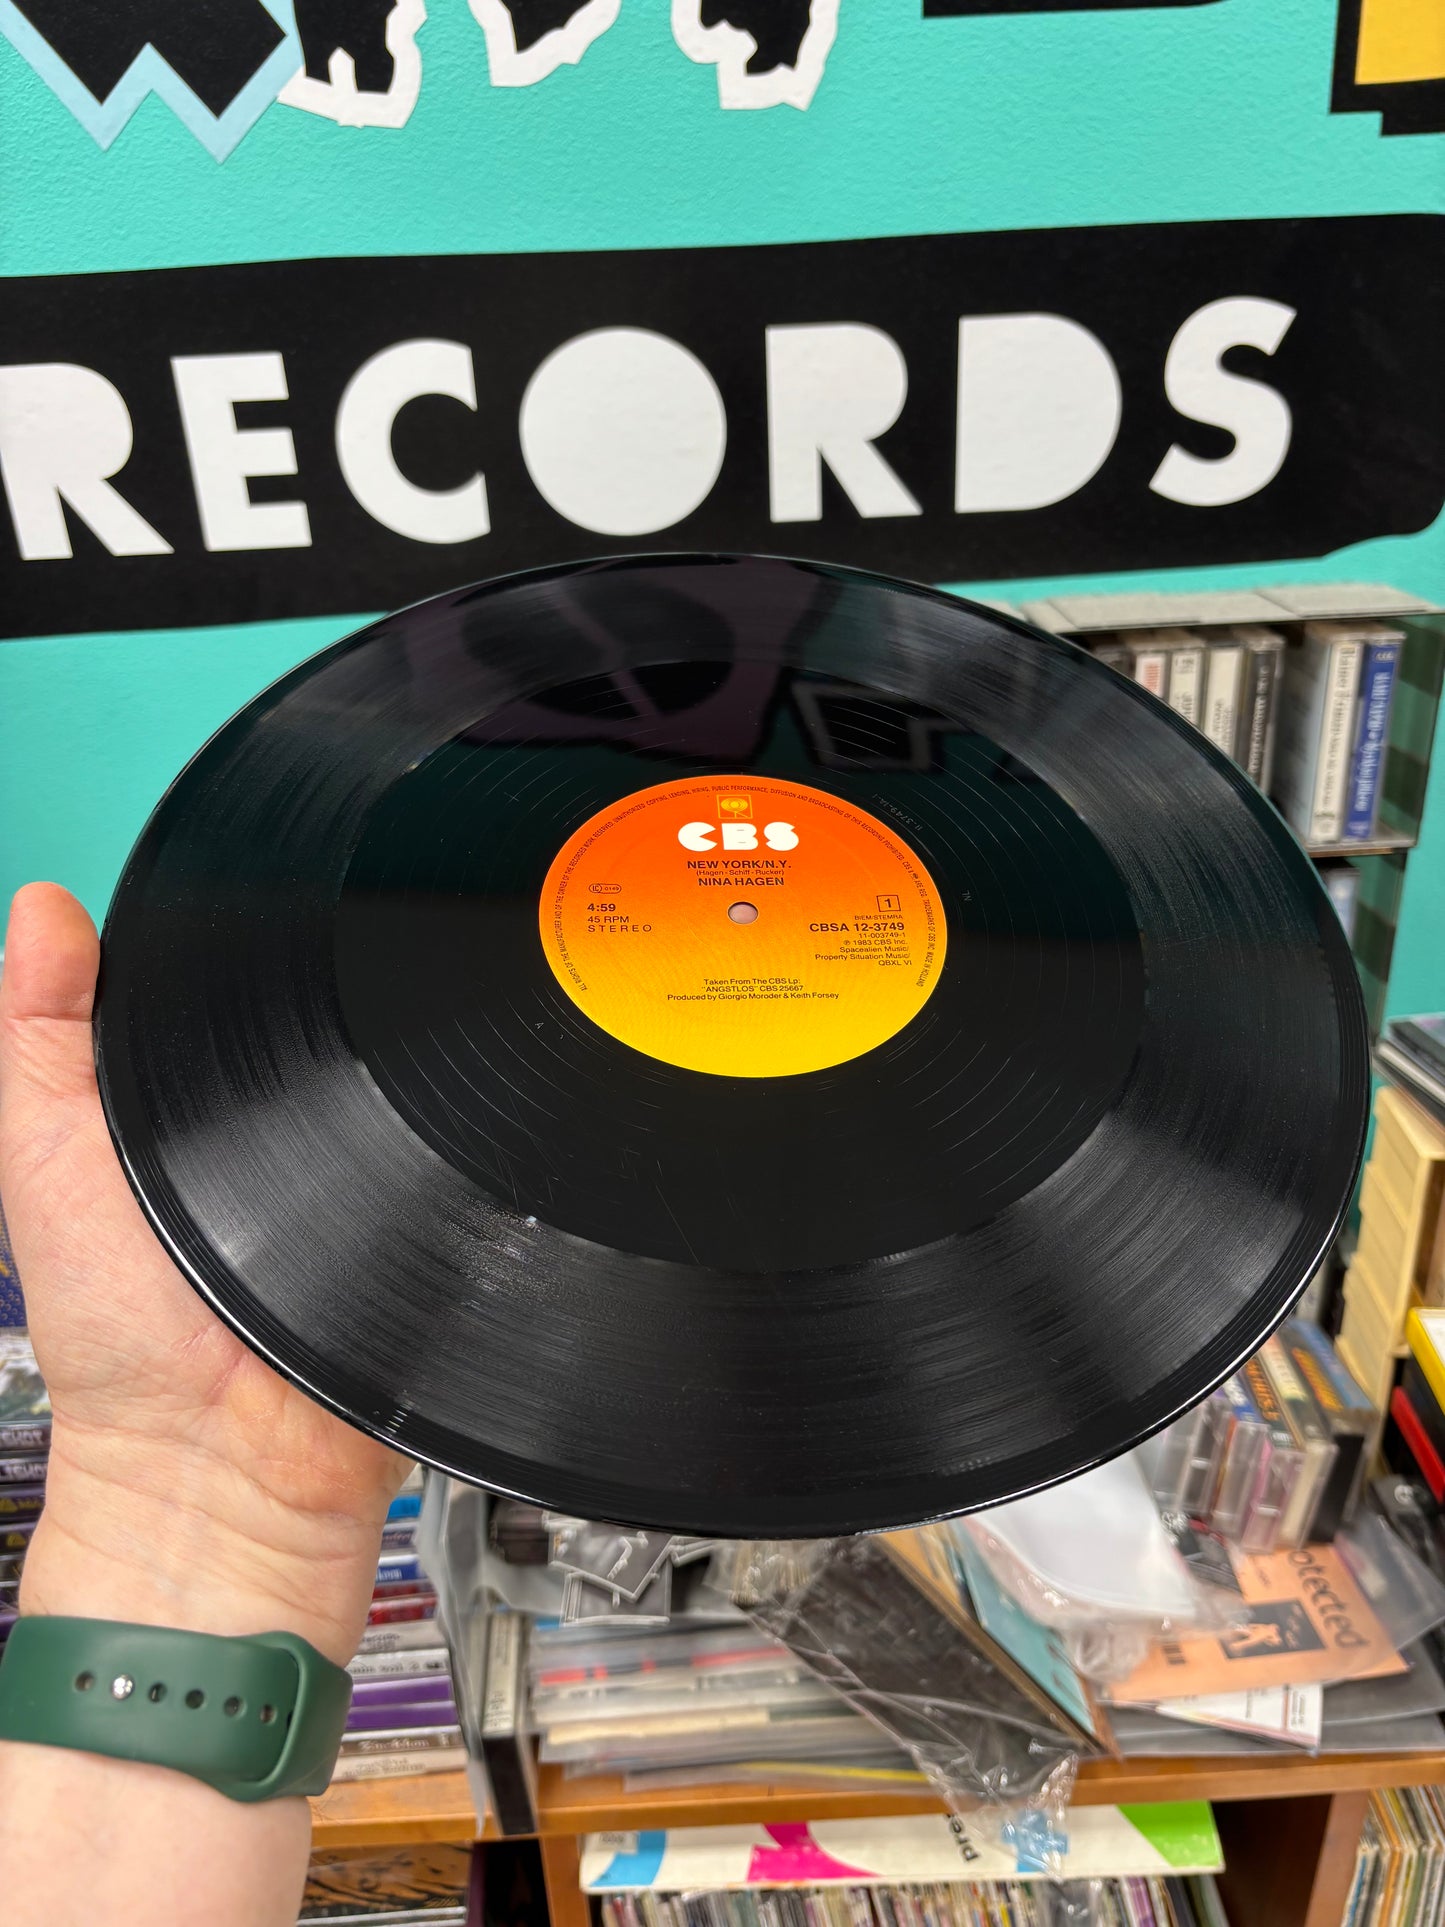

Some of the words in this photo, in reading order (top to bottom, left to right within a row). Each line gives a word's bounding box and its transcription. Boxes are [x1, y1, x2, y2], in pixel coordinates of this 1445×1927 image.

[0, 295, 1297, 561] RECORDS
[678, 821, 799, 852] CBS
[687, 860, 719, 869] NEW
[721, 860, 792, 869] YORK/N.Y.
[698, 878, 732, 886] NINA
[735, 877, 785, 886] HAGEN
[587, 903, 616, 912] 4:59
[884, 898, 892, 908] 1
[587, 915, 601, 923] 45
[603, 915, 629, 923] RPM
[587, 924, 652, 933] STEREO
[809, 922, 850, 932] CBSA
[854, 922, 905, 932] 12-3749
[839, 946, 882, 954] Spacealien
[815, 953, 848, 961] Property
[667, 993, 706, 1001] Produced
[718, 993, 747, 1001] Giorgio
[812, 992, 840, 1000] Forsey
